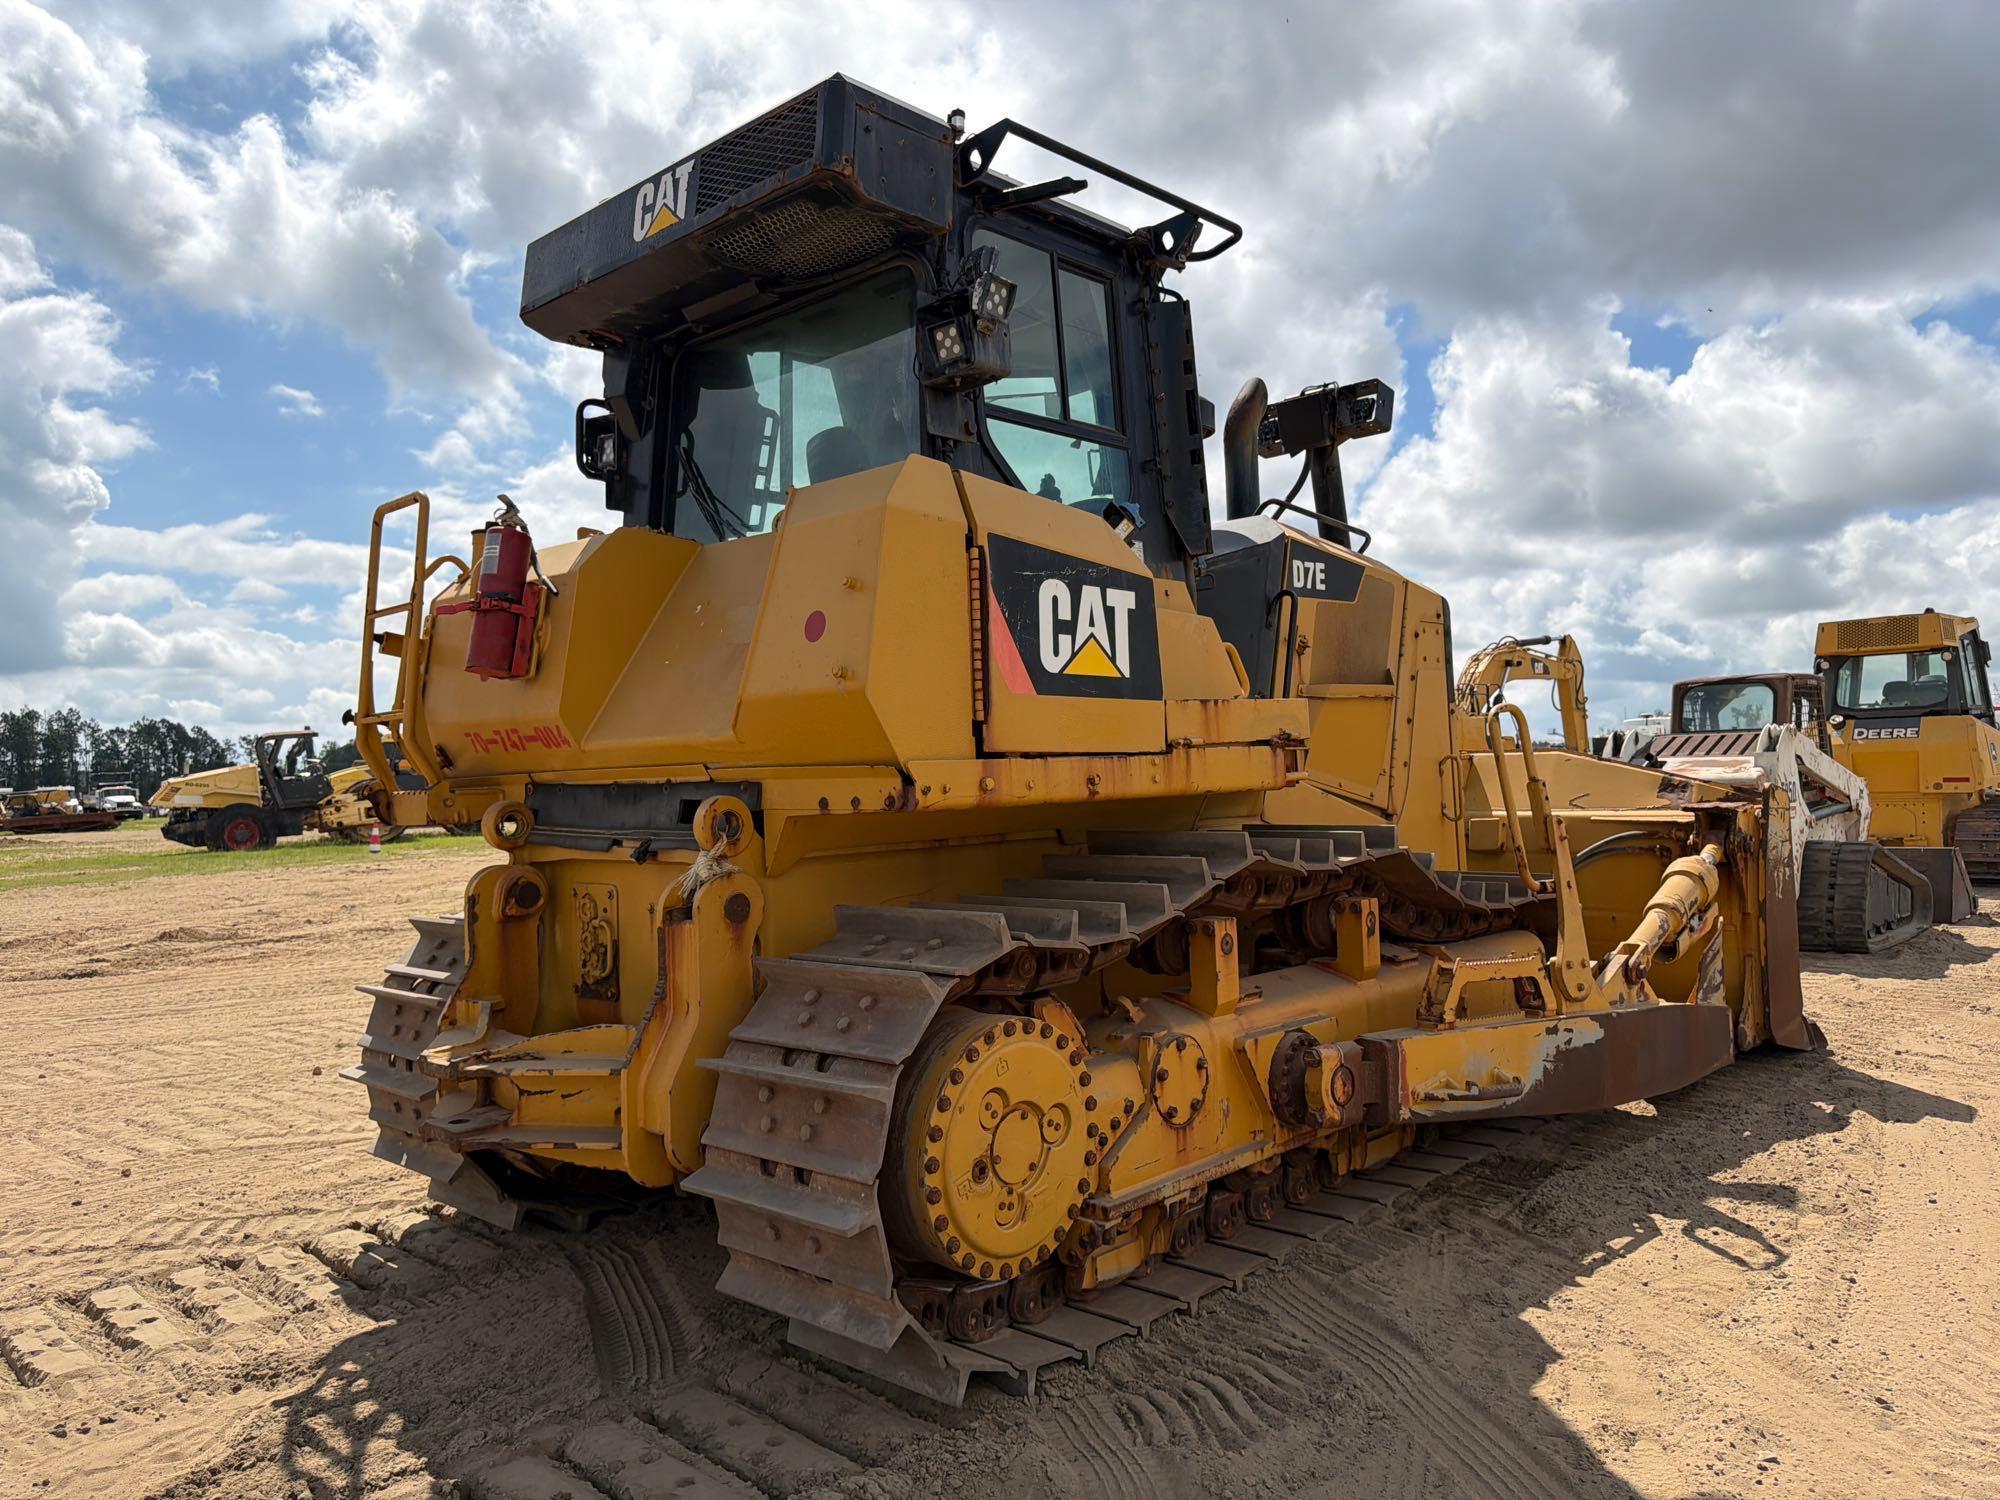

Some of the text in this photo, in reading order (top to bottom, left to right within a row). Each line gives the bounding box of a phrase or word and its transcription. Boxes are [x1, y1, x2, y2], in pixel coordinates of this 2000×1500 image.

[633, 159, 696, 242] CAT
[1292, 559, 1326, 590] D7E
[1038, 578, 1136, 678] CAT
[1853, 727, 1919, 740] DEERE
